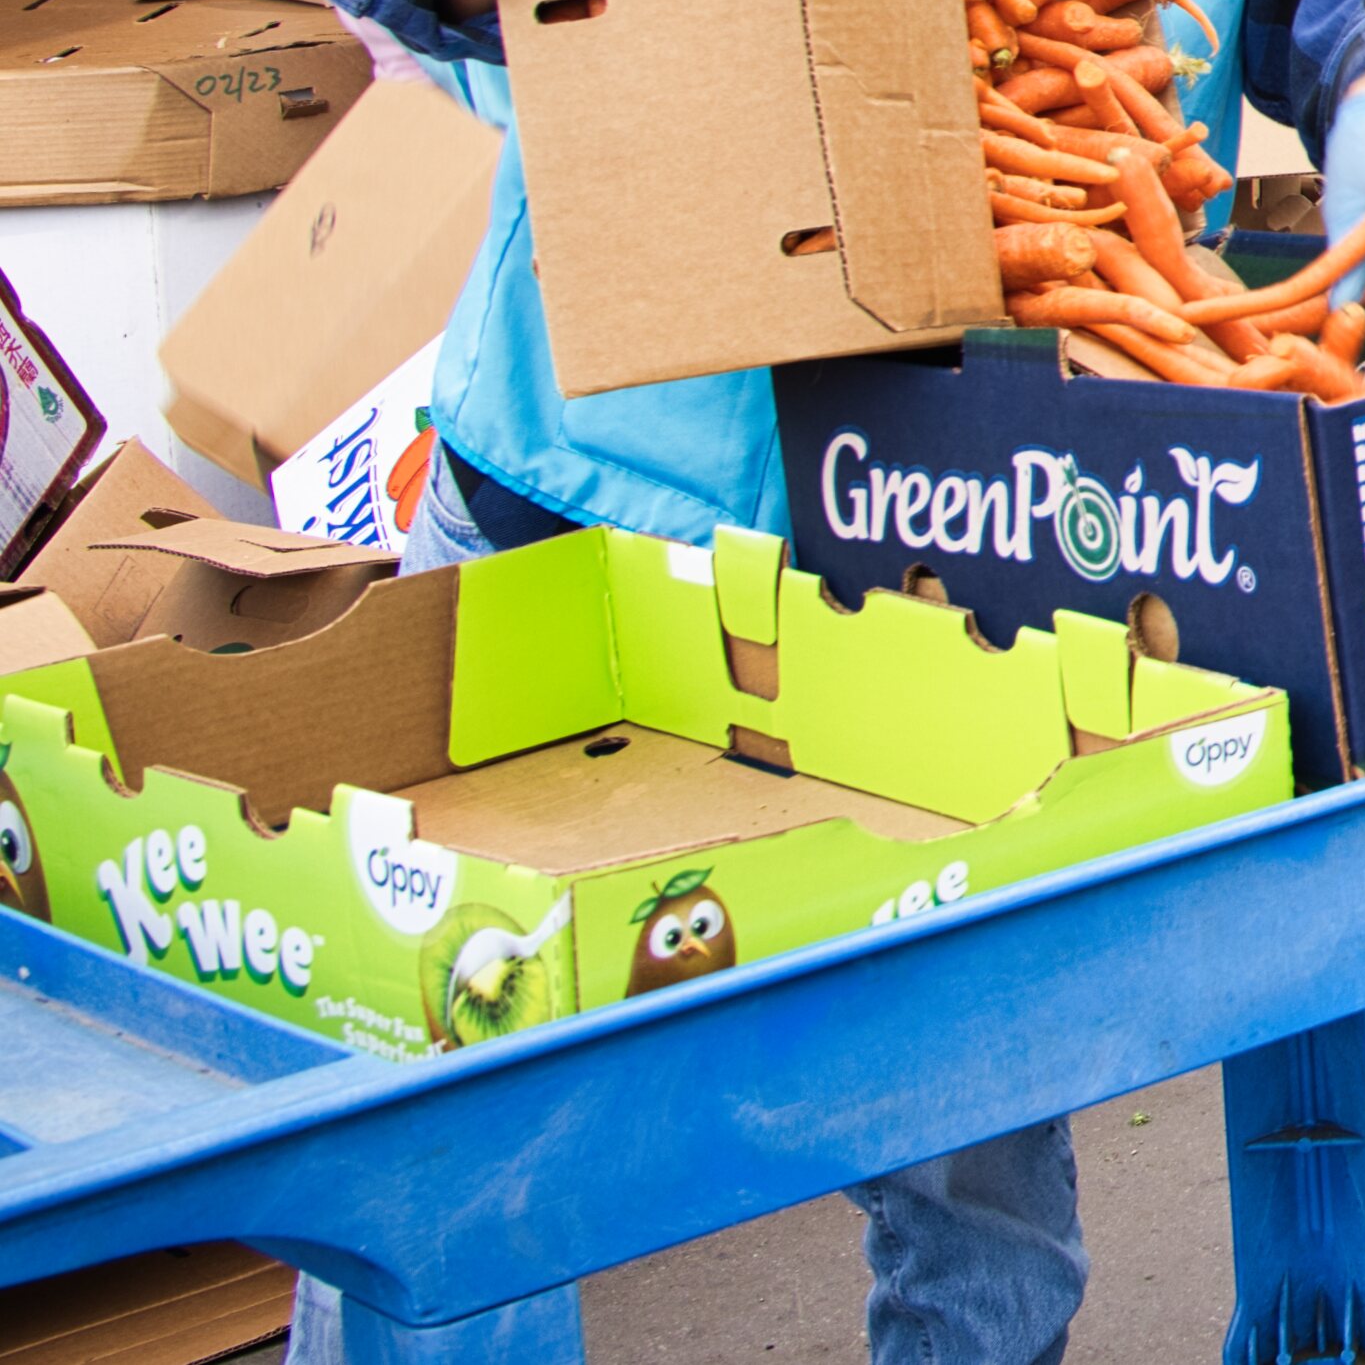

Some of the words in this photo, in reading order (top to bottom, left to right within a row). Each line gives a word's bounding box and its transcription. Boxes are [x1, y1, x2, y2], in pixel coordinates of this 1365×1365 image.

[195, 65, 283, 102] 02/23
[303, 407, 387, 551] kist
[821, 431, 1260, 585] GreenPoint
[98, 823, 207, 966] Kee
[177, 897, 316, 988] Wee
